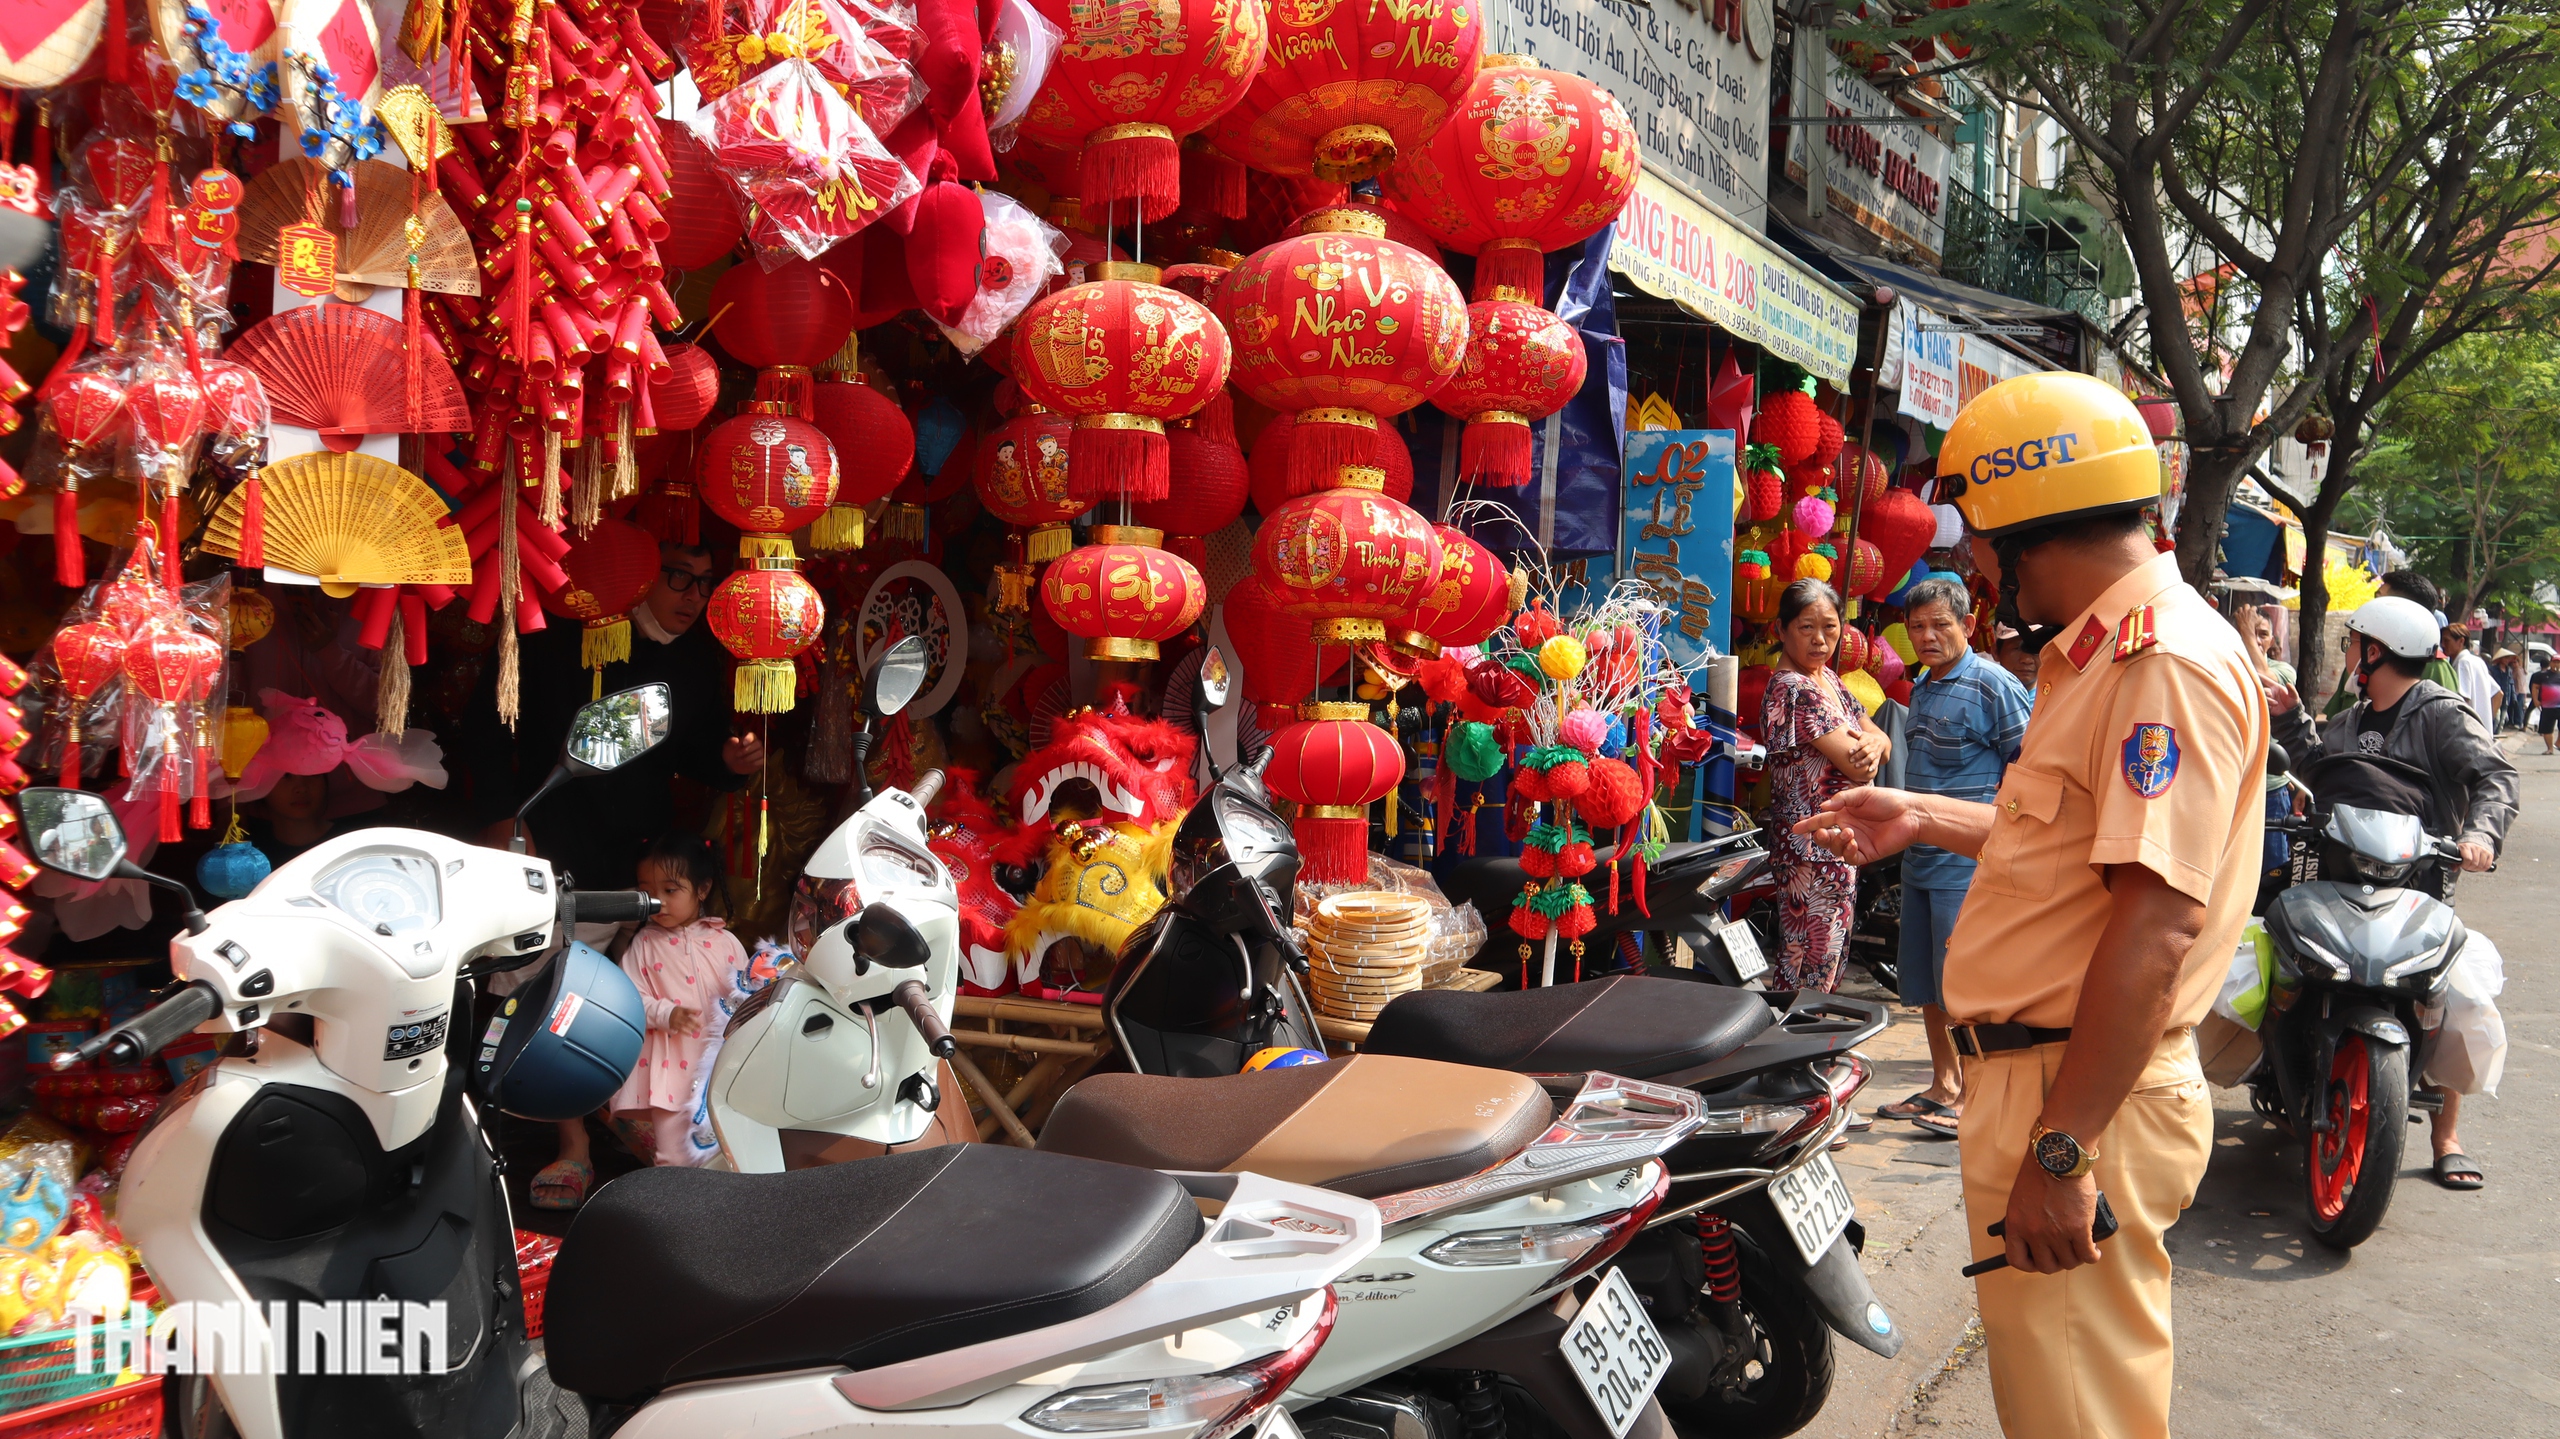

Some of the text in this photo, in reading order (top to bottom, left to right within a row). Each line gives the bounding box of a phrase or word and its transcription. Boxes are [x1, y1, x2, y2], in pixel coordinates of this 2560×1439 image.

[1395, 25, 1460, 70] Nước
[1647, 9, 1660, 43] &
[1687, 38, 1713, 81] Các
[1472, 98, 1489, 108] an
[1575, 10, 1600, 65] Hội
[1604, 31, 1629, 83] An,
[1668, 68, 1692, 118] Đèn
[1696, 90, 1730, 149] Trung
[1732, 121, 1760, 163] Quốc
[1467, 106, 1496, 120] khang
[1646, 112, 1673, 166] Hỏi,
[1677, 132, 1704, 174] Sinh
[1708, 153, 1737, 200] Nhật
[1902, 126, 1921, 151] 204
[1884, 152, 1940, 217] HOÀNG
[1670, 212, 1718, 291] HOA
[1724, 250, 1757, 313] 208
[1762, 262, 1791, 301] CHUYÊN
[1358, 266, 1414, 308] Vô
[1290, 292, 1367, 339] Như
[1328, 335, 1396, 370] Nước
[1062, 389, 1109, 408] Quý
[1133, 390, 1175, 408] Mới
[1155, 376, 1197, 393] Năm
[1520, 380, 1546, 396] Lộc
[1969, 432, 2079, 486] CSGT
[1354, 541, 1402, 569] Thịnh
[1108, 563, 1170, 612] Sự
[2128, 762, 2170, 778] CSGT
[1778, 1157, 1830, 1214] 59-HA
[1796, 1179, 1848, 1254] 072.20
[1572, 1286, 1633, 1375] 59-L3
[1596, 1324, 1662, 1428] 204.36
